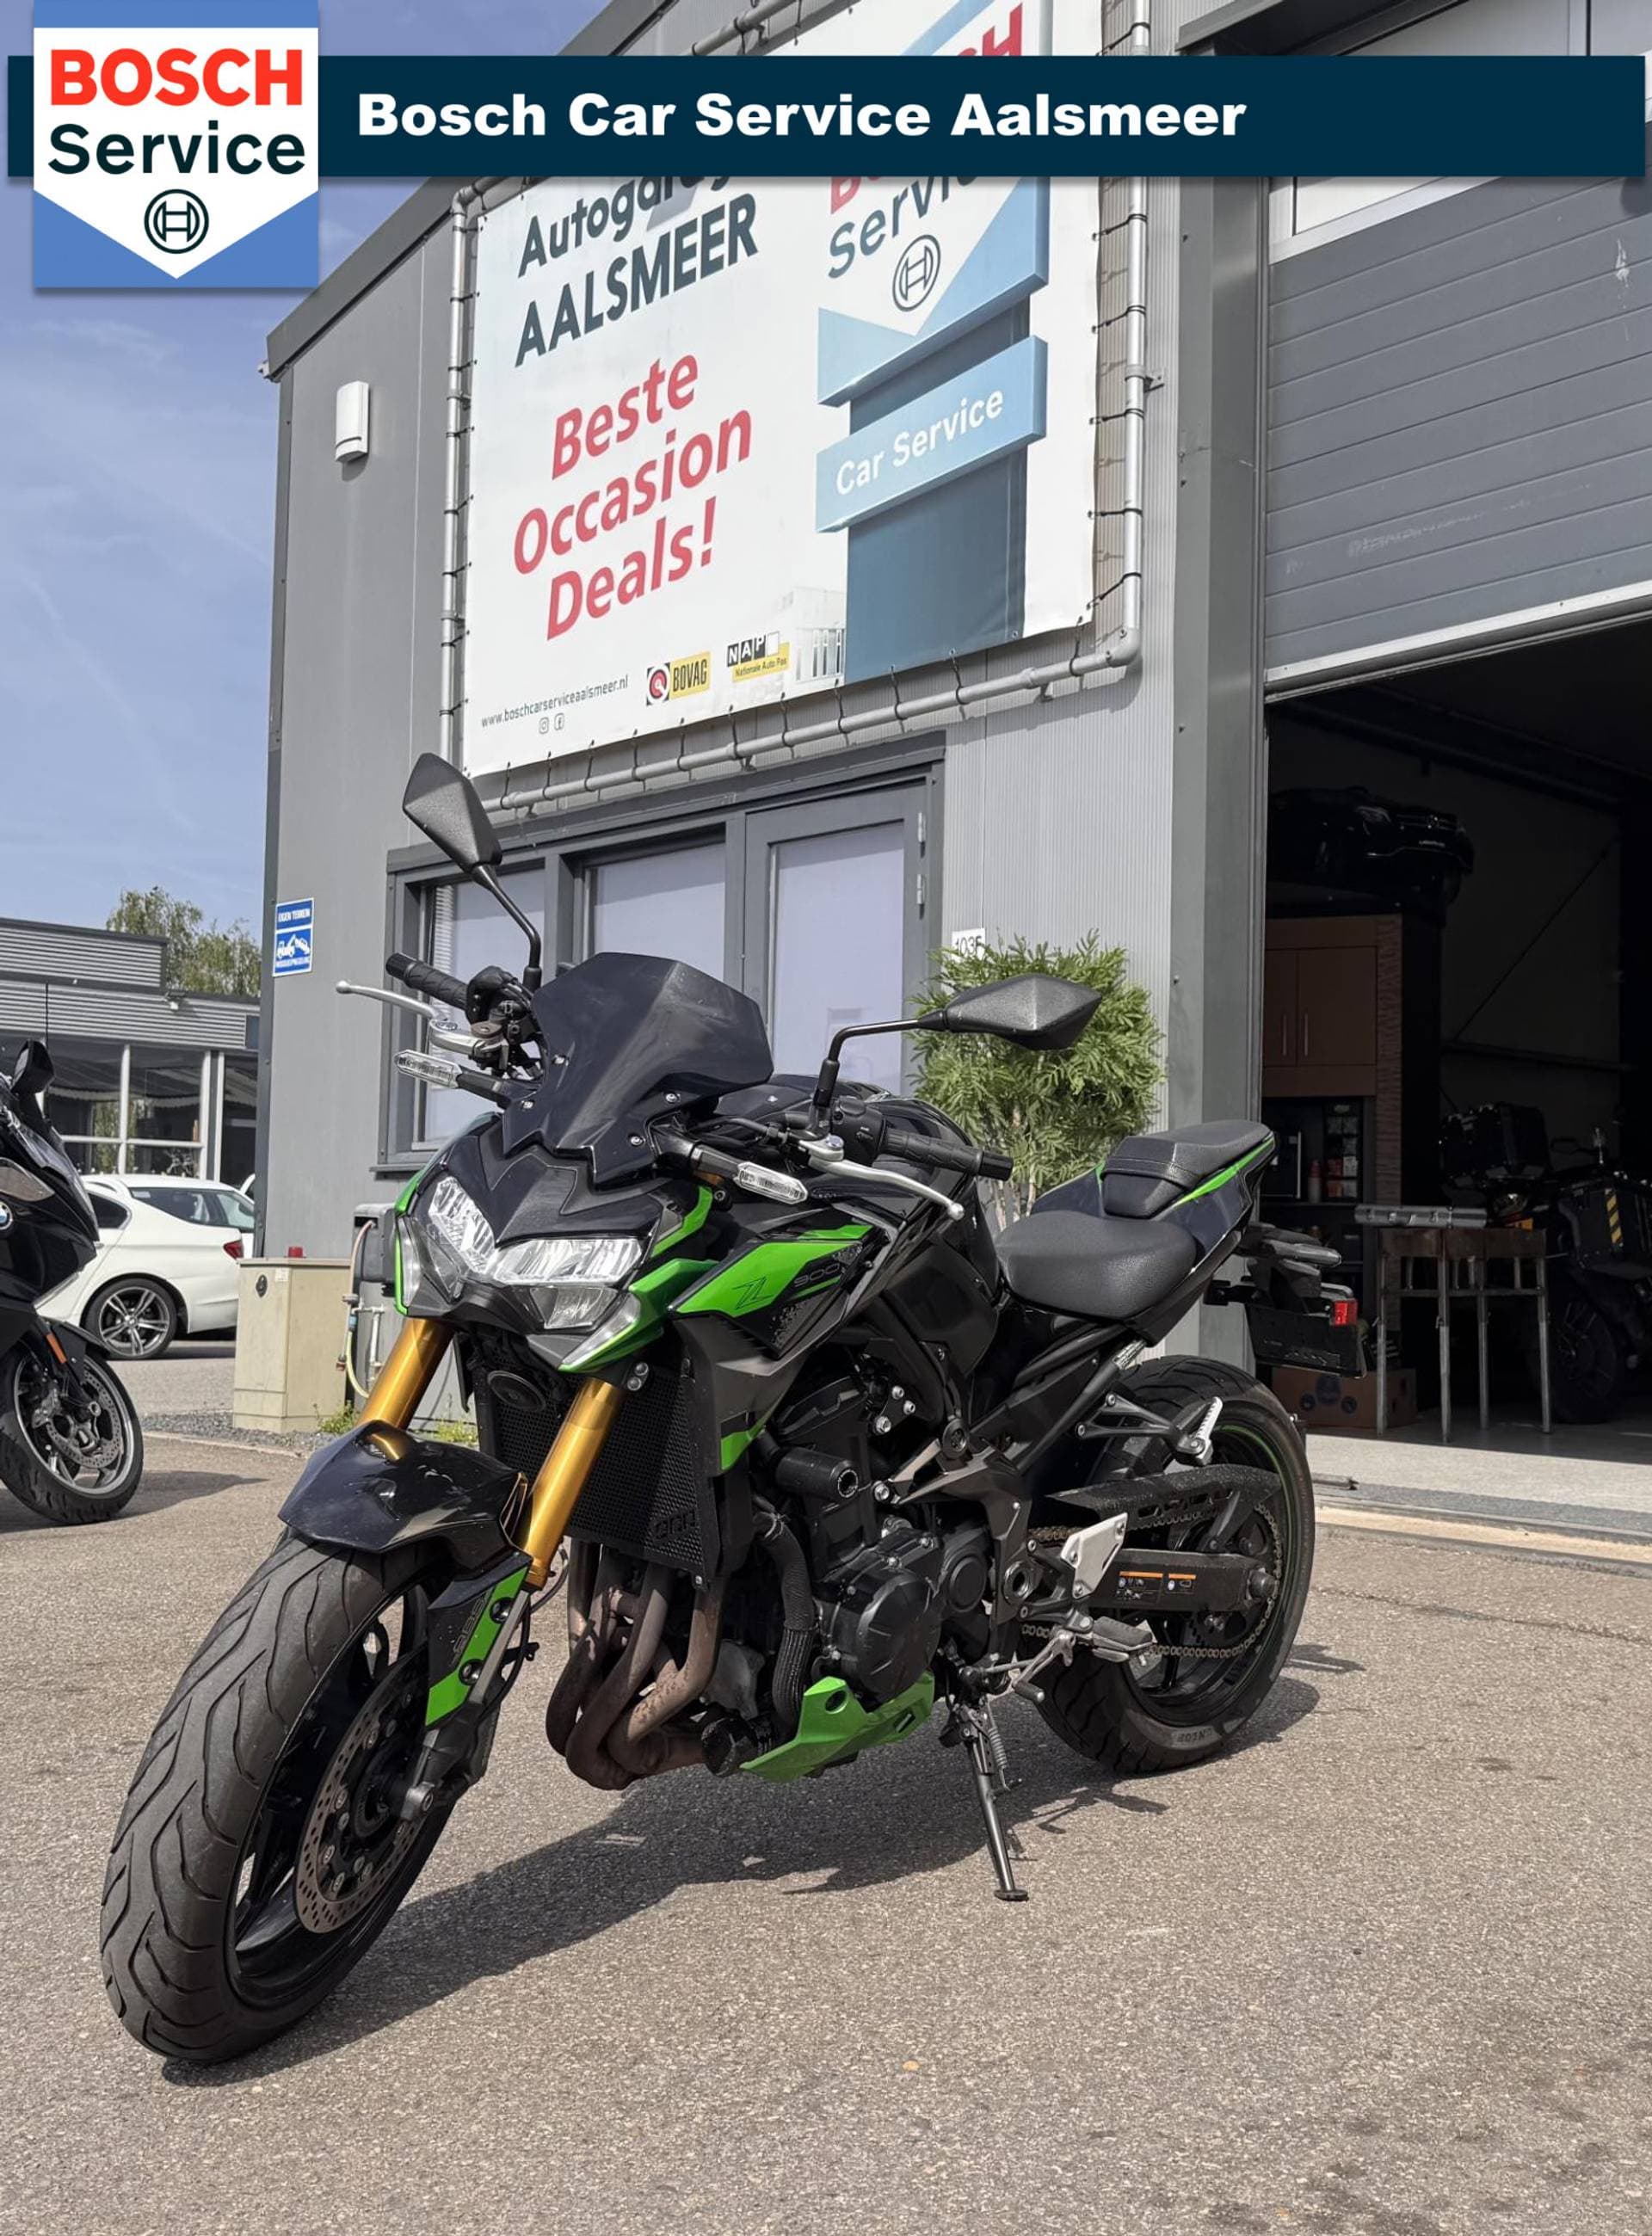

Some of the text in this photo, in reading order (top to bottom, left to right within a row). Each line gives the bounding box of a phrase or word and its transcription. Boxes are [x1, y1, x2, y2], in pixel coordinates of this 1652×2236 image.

[518, 176, 730, 279] Autoga
[829, 176, 977, 279] Serv
[515, 193, 758, 369] AALSMEER
[552, 354, 698, 481] Beste
[836, 390, 1003, 495] Car Service
[514, 410, 752, 576] Occasion
[546, 496, 717, 641] Deals!
[481, 674, 628, 728] www.boschcarserviceaalsmeer.nl
[673, 659, 708, 693] BOVAG
[727, 635, 766, 668] NAP
[794, 1263, 841, 1288] 900
